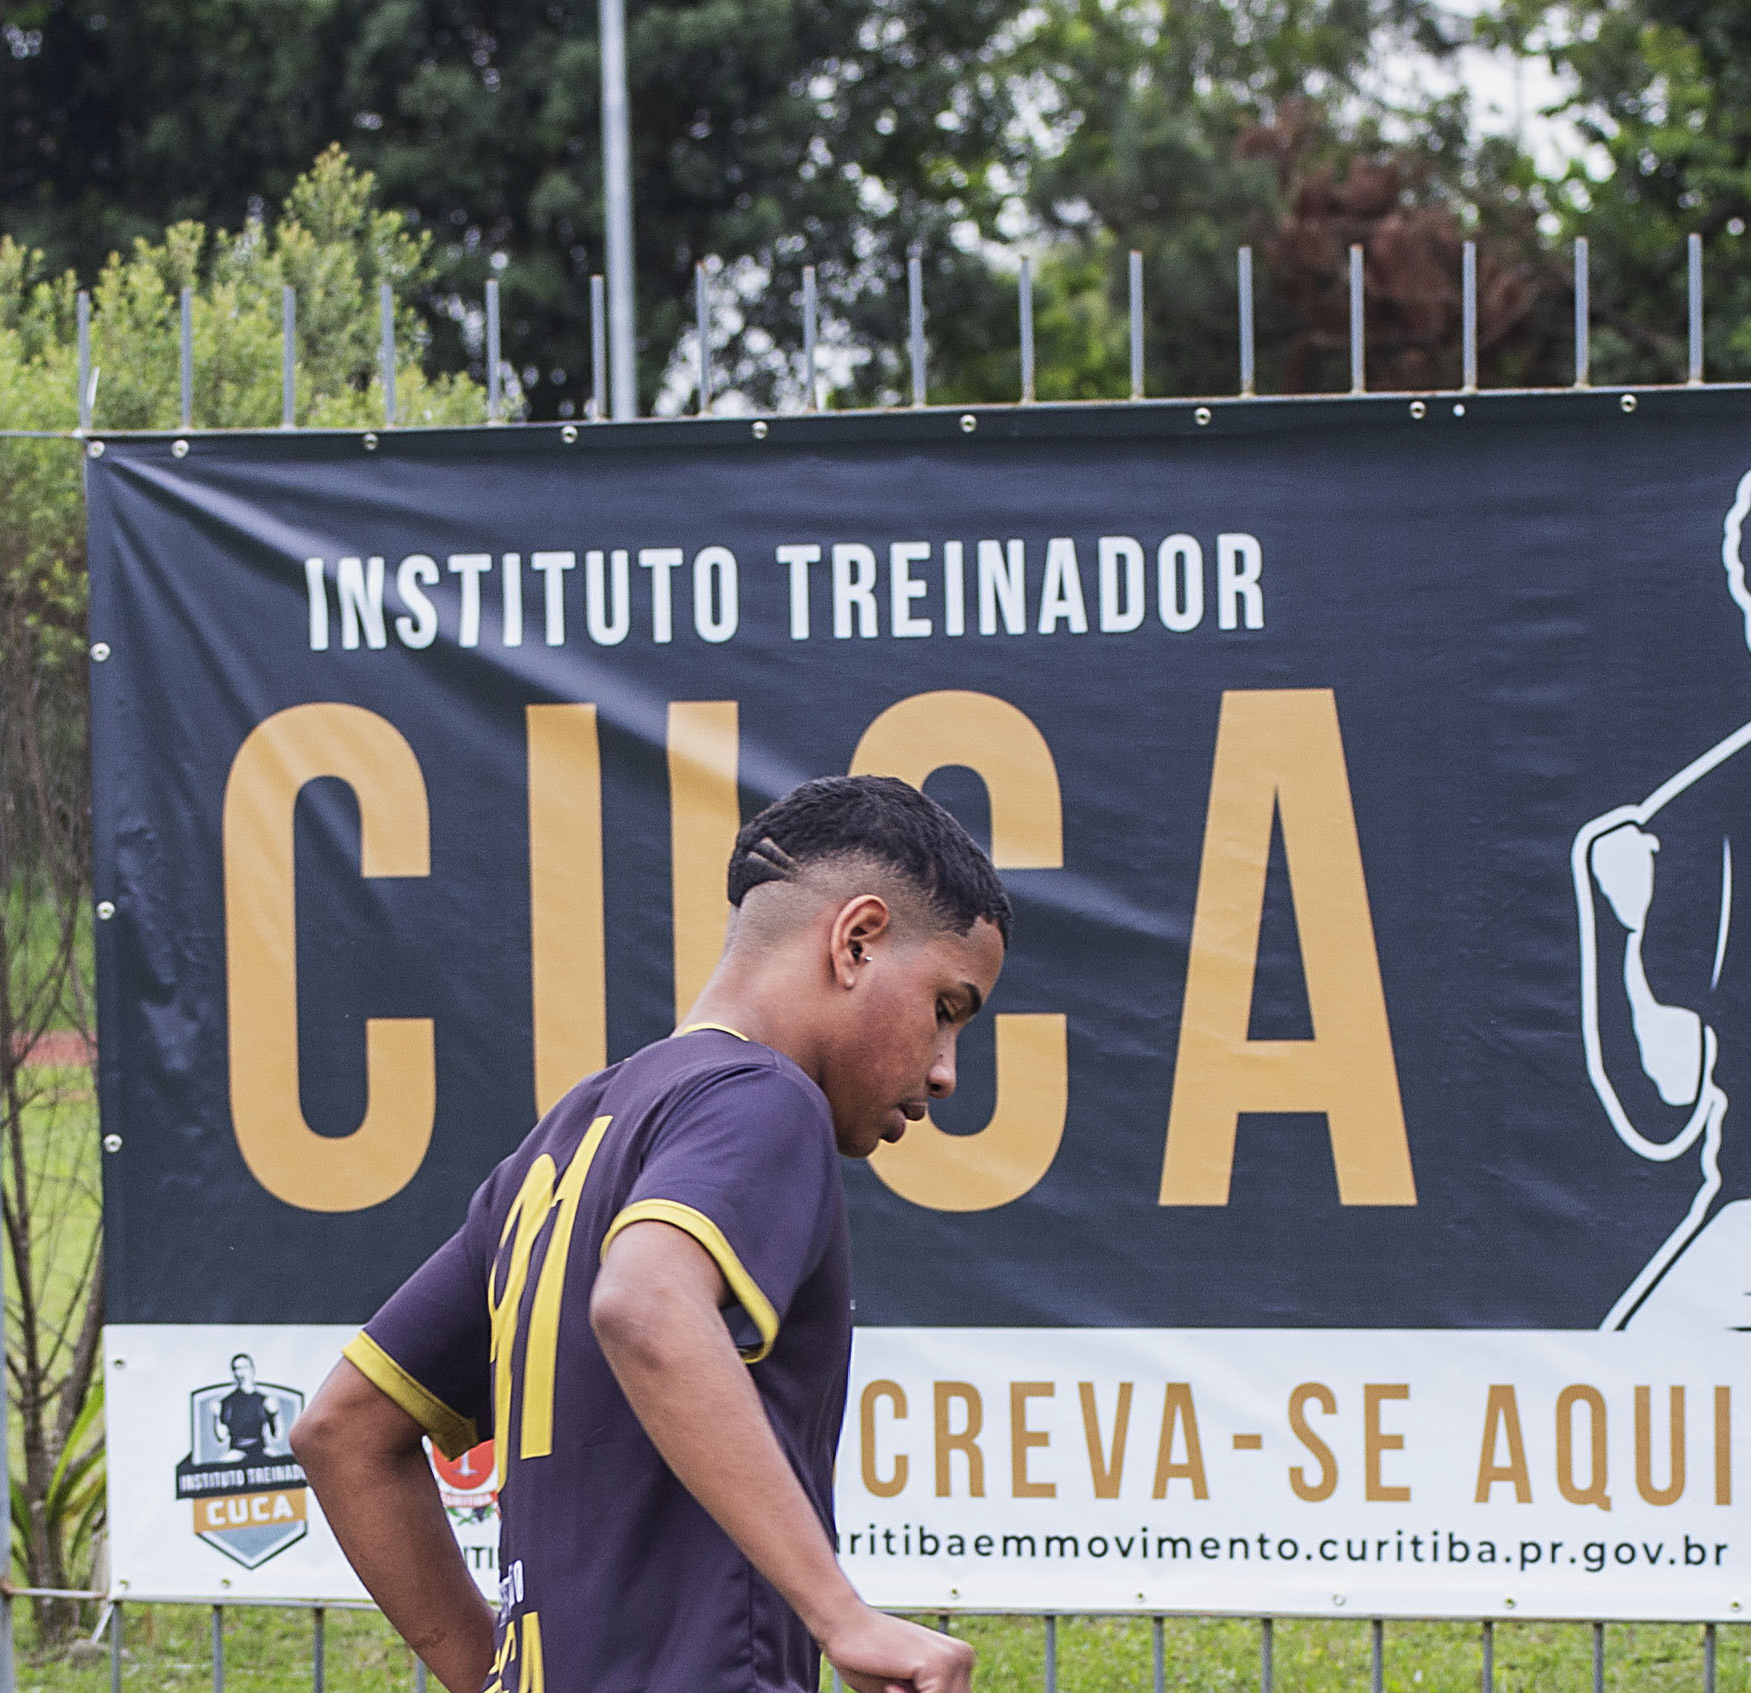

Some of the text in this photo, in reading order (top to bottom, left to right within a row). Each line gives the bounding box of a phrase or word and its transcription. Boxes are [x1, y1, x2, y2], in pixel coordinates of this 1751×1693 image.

[305, 533, 1264, 651] INSTITUTO TREINADOR
[222, 688, 1418, 1212] CUCA
[180, 1467, 245, 1492] INSTITUTO
[833, 1379, 1732, 1512] CREVA-SE AQUI
[206, 1495, 293, 1525] CUCA
